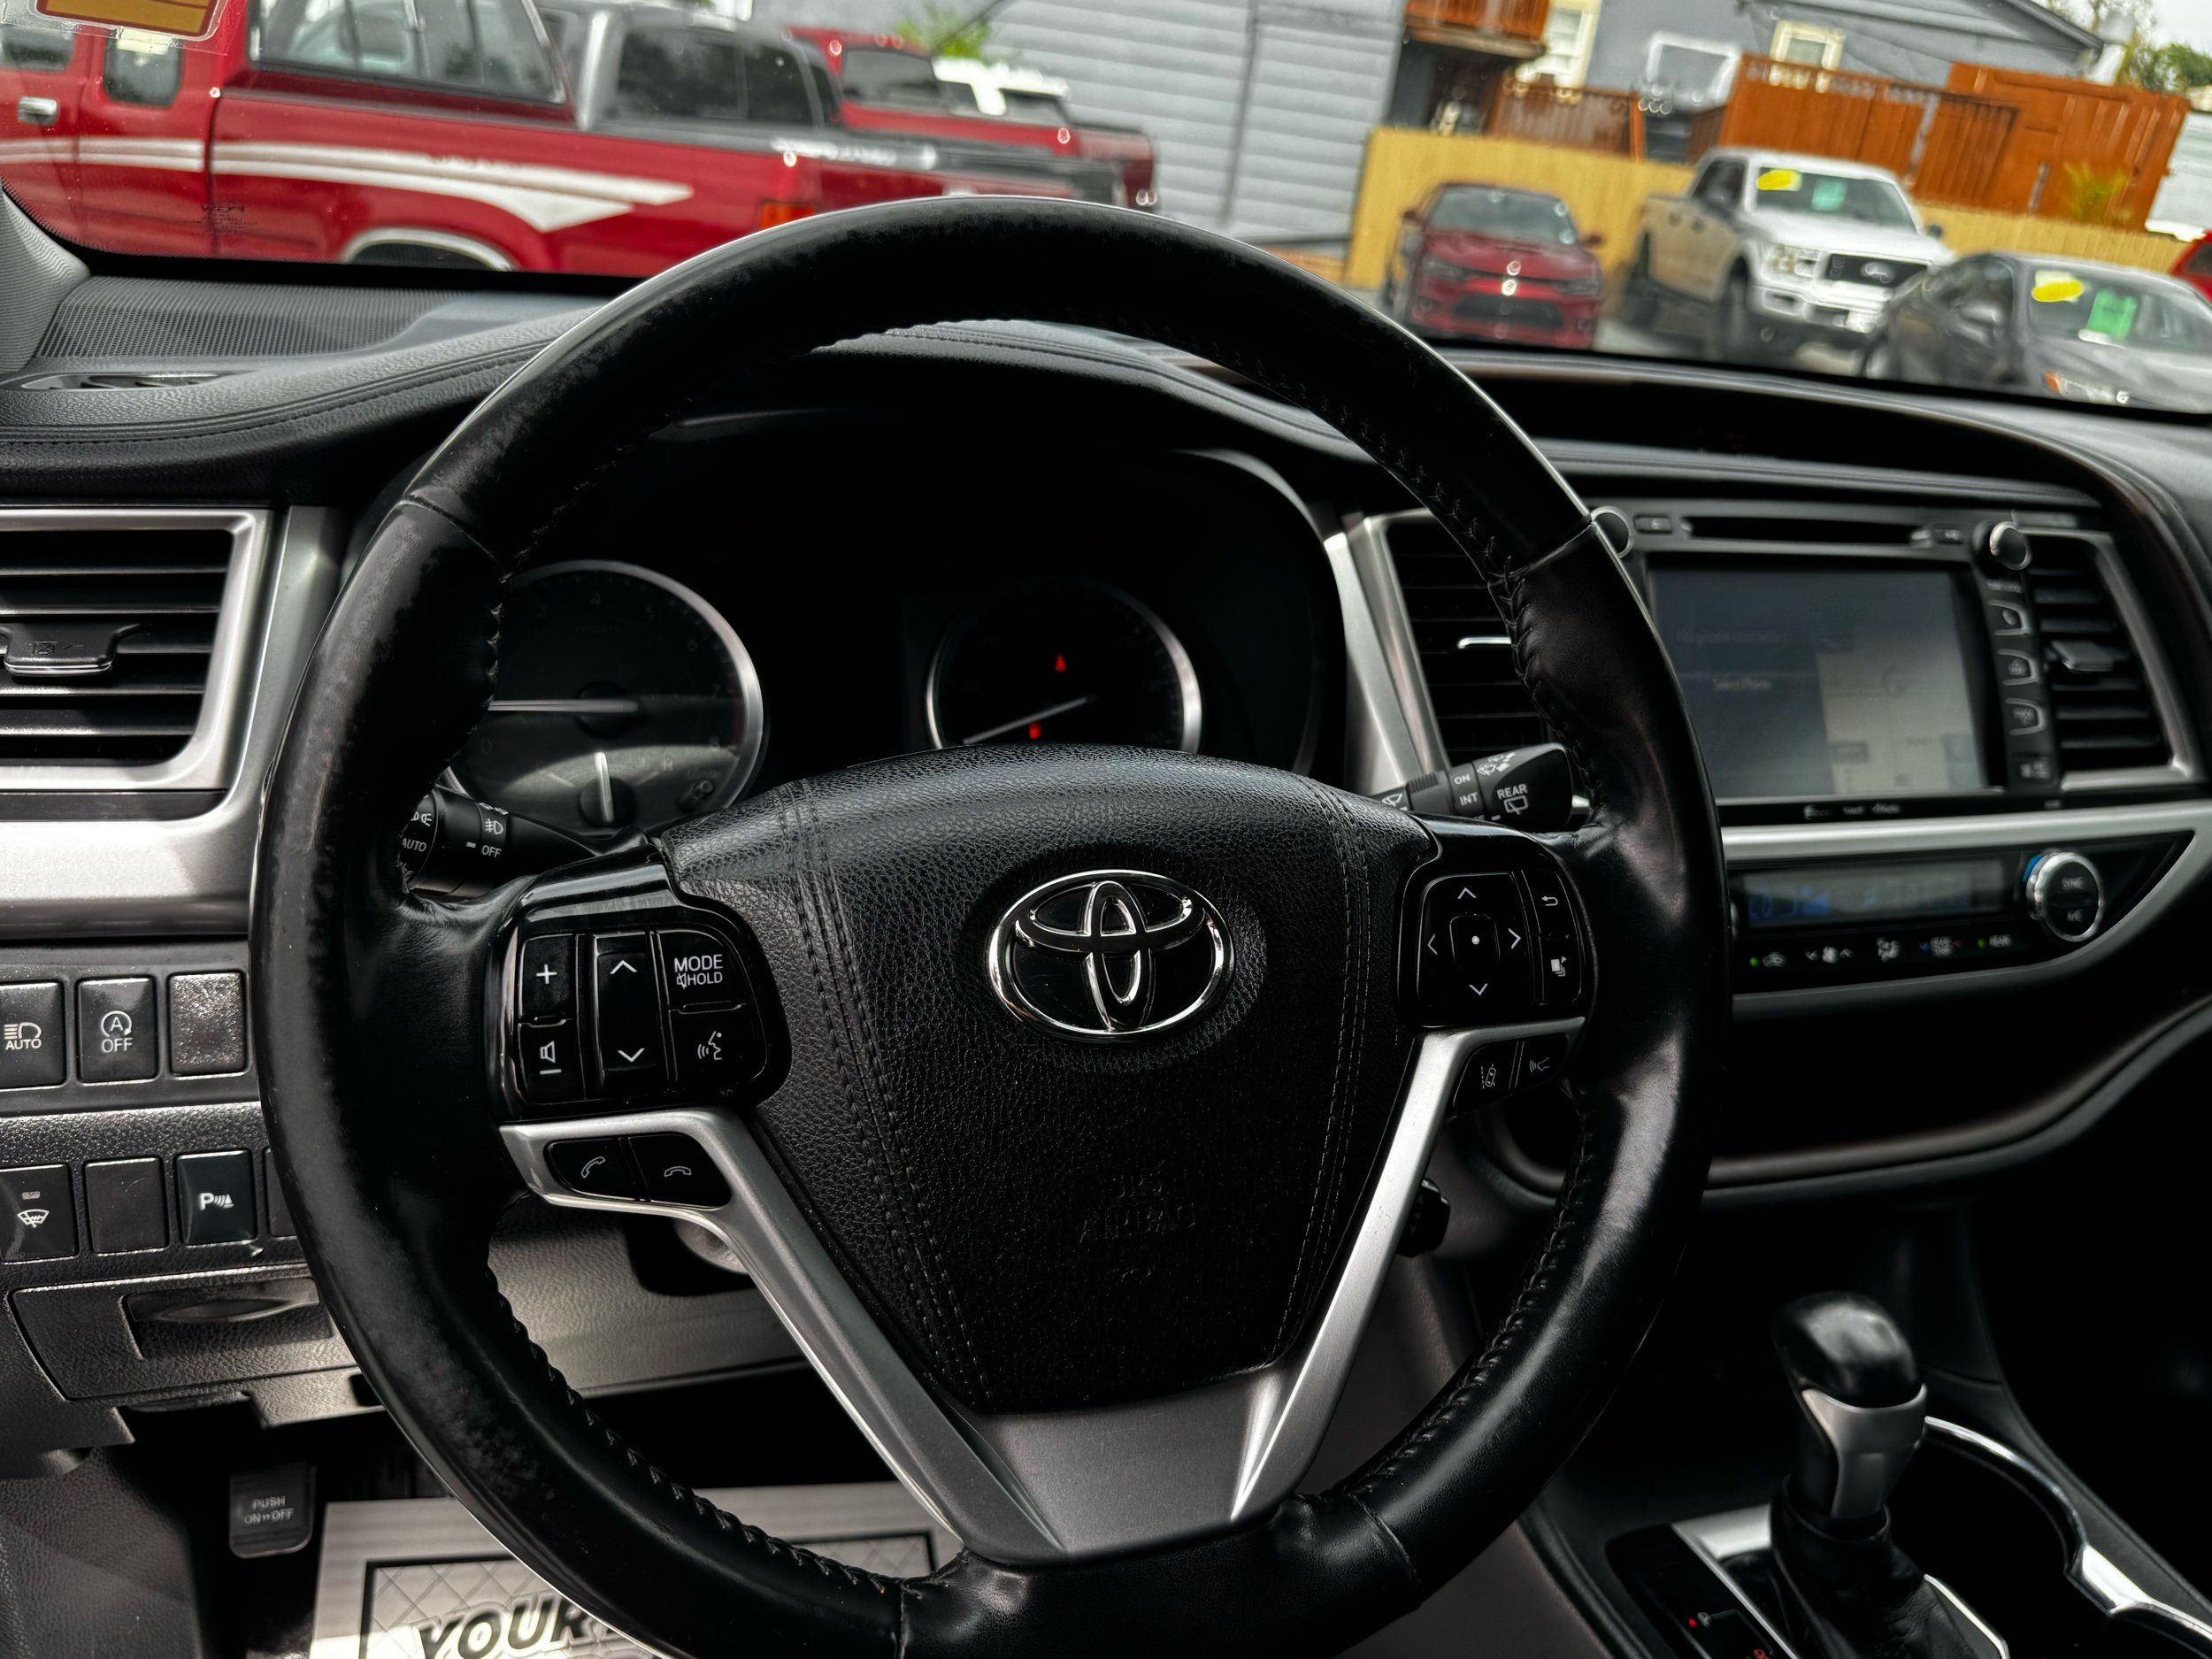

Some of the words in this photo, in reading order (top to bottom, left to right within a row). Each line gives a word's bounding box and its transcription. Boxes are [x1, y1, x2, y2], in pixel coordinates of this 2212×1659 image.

[1454, 772, 1471, 785] ON
[1459, 791, 1479, 806] INT
[1496, 783, 1529, 800] REAR
[402, 837, 427, 852] AUTO
[480, 844, 503, 858] OFF
[673, 954, 724, 973] MODE
[687, 971, 724, 987] HOLD
[4, 1038, 42, 1051] AUTO
[100, 1037, 134, 1054] OFF
[251, 1495, 286, 1509] PUSH
[244, 1512, 263, 1525] ON
[270, 1507, 296, 1523] OFF
[416, 1596, 588, 1659] YOUR
